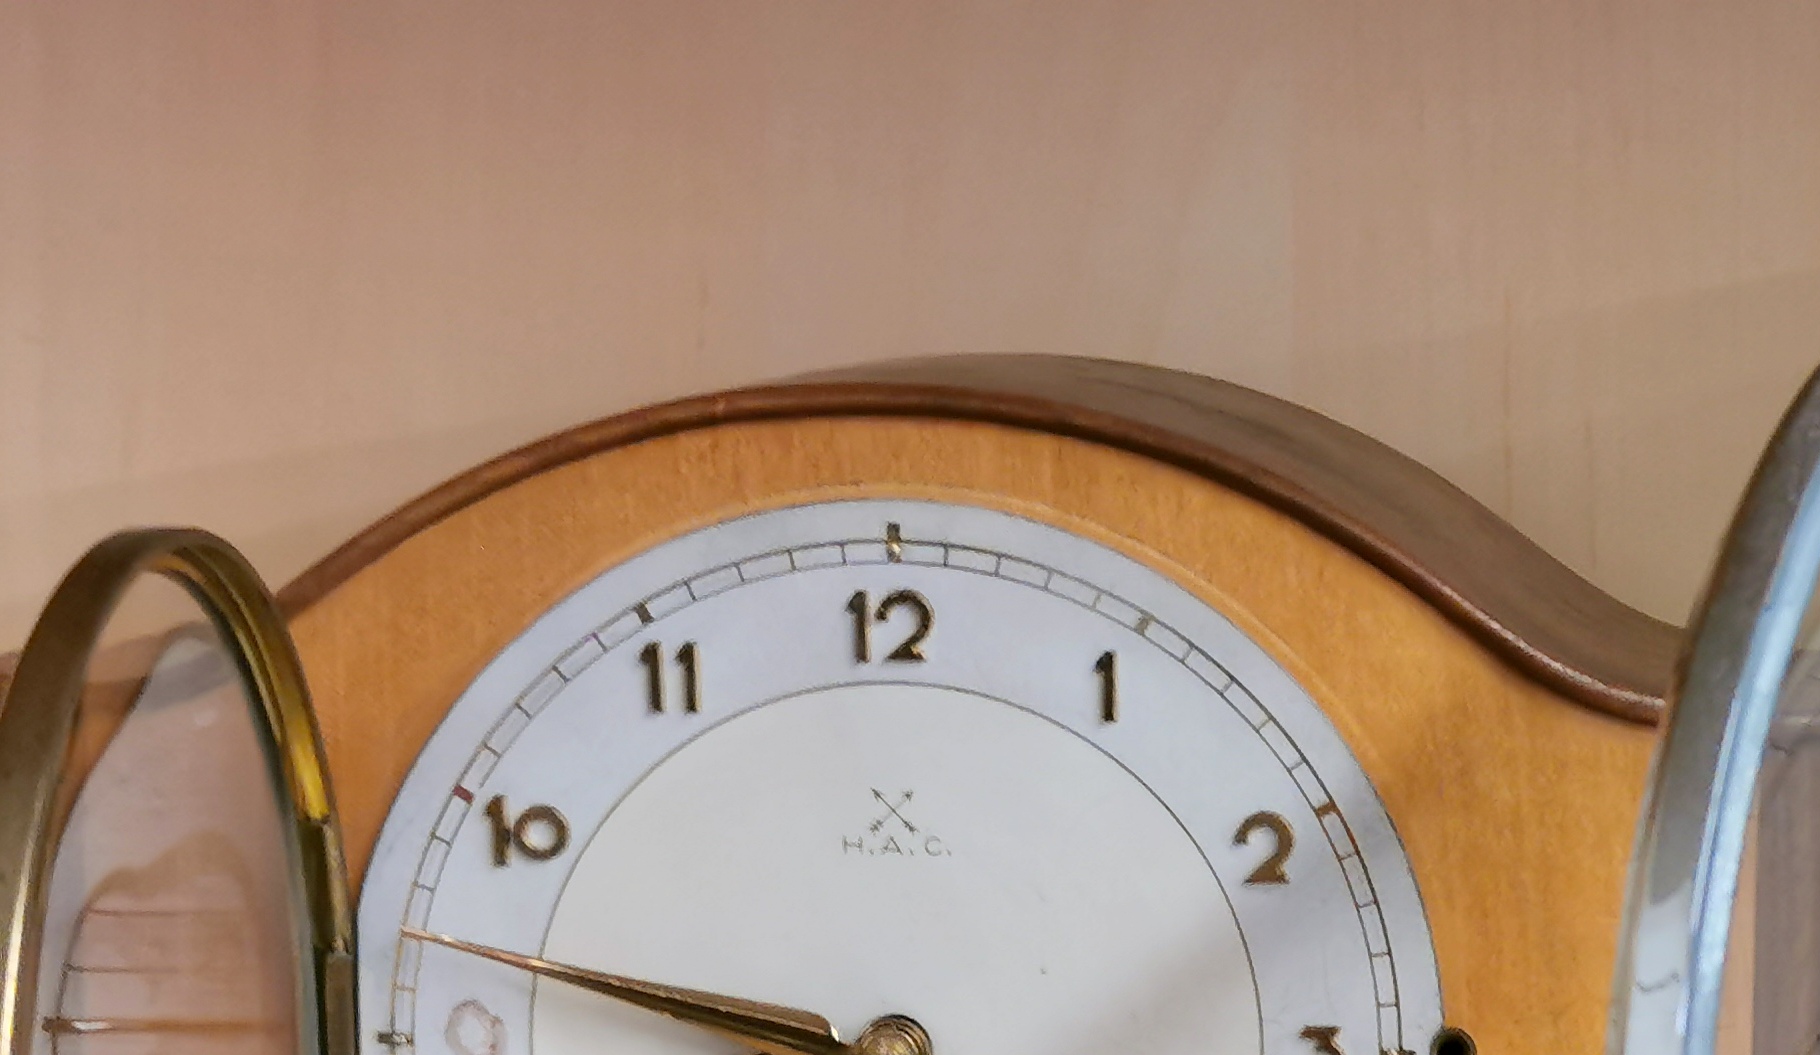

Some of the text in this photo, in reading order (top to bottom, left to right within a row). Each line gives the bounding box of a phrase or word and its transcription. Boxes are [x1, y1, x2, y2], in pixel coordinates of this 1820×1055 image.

[844, 590, 935, 662] 12
[641, 641, 702, 714] 11
[1093, 652, 1119, 723] 1
[484, 797, 569, 865] 10
[1233, 813, 1295, 884] 2
